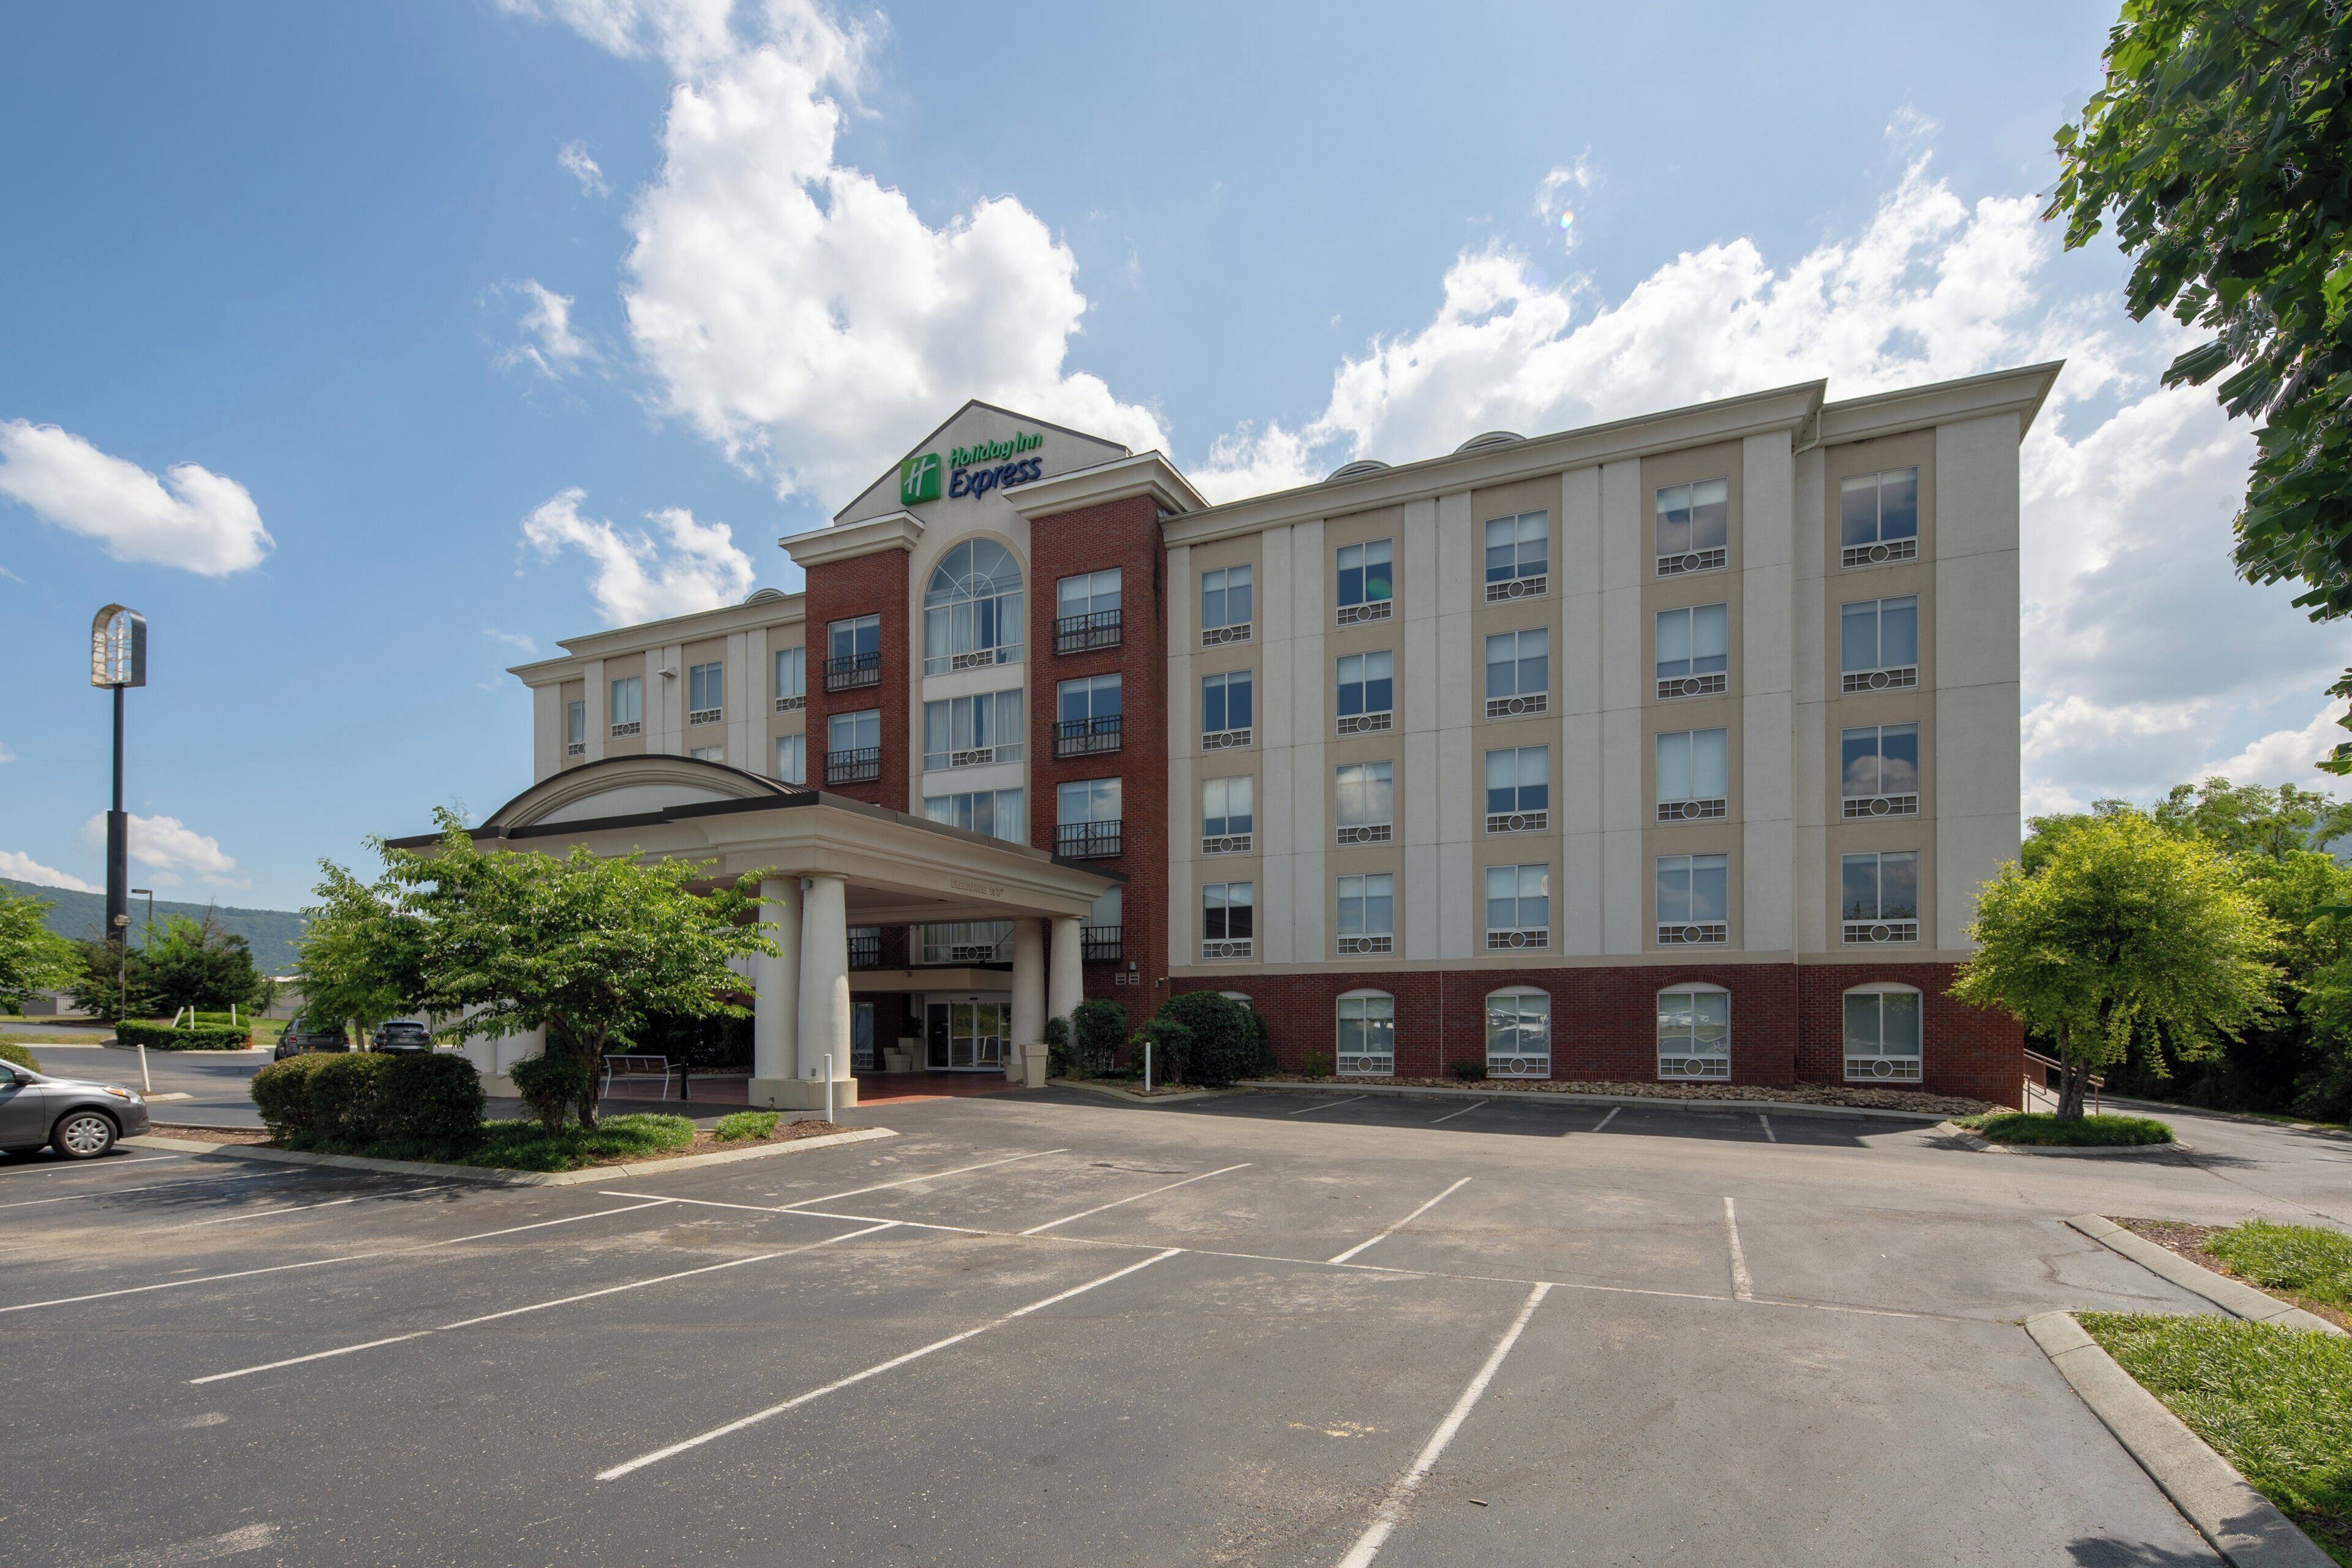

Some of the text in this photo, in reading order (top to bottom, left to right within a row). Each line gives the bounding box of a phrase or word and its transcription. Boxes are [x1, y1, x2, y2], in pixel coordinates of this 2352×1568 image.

[949, 431, 1042, 469] Holiday Inn
[948, 457, 1042, 500] Express
[951, 878, 986, 894] CLEARANCE
